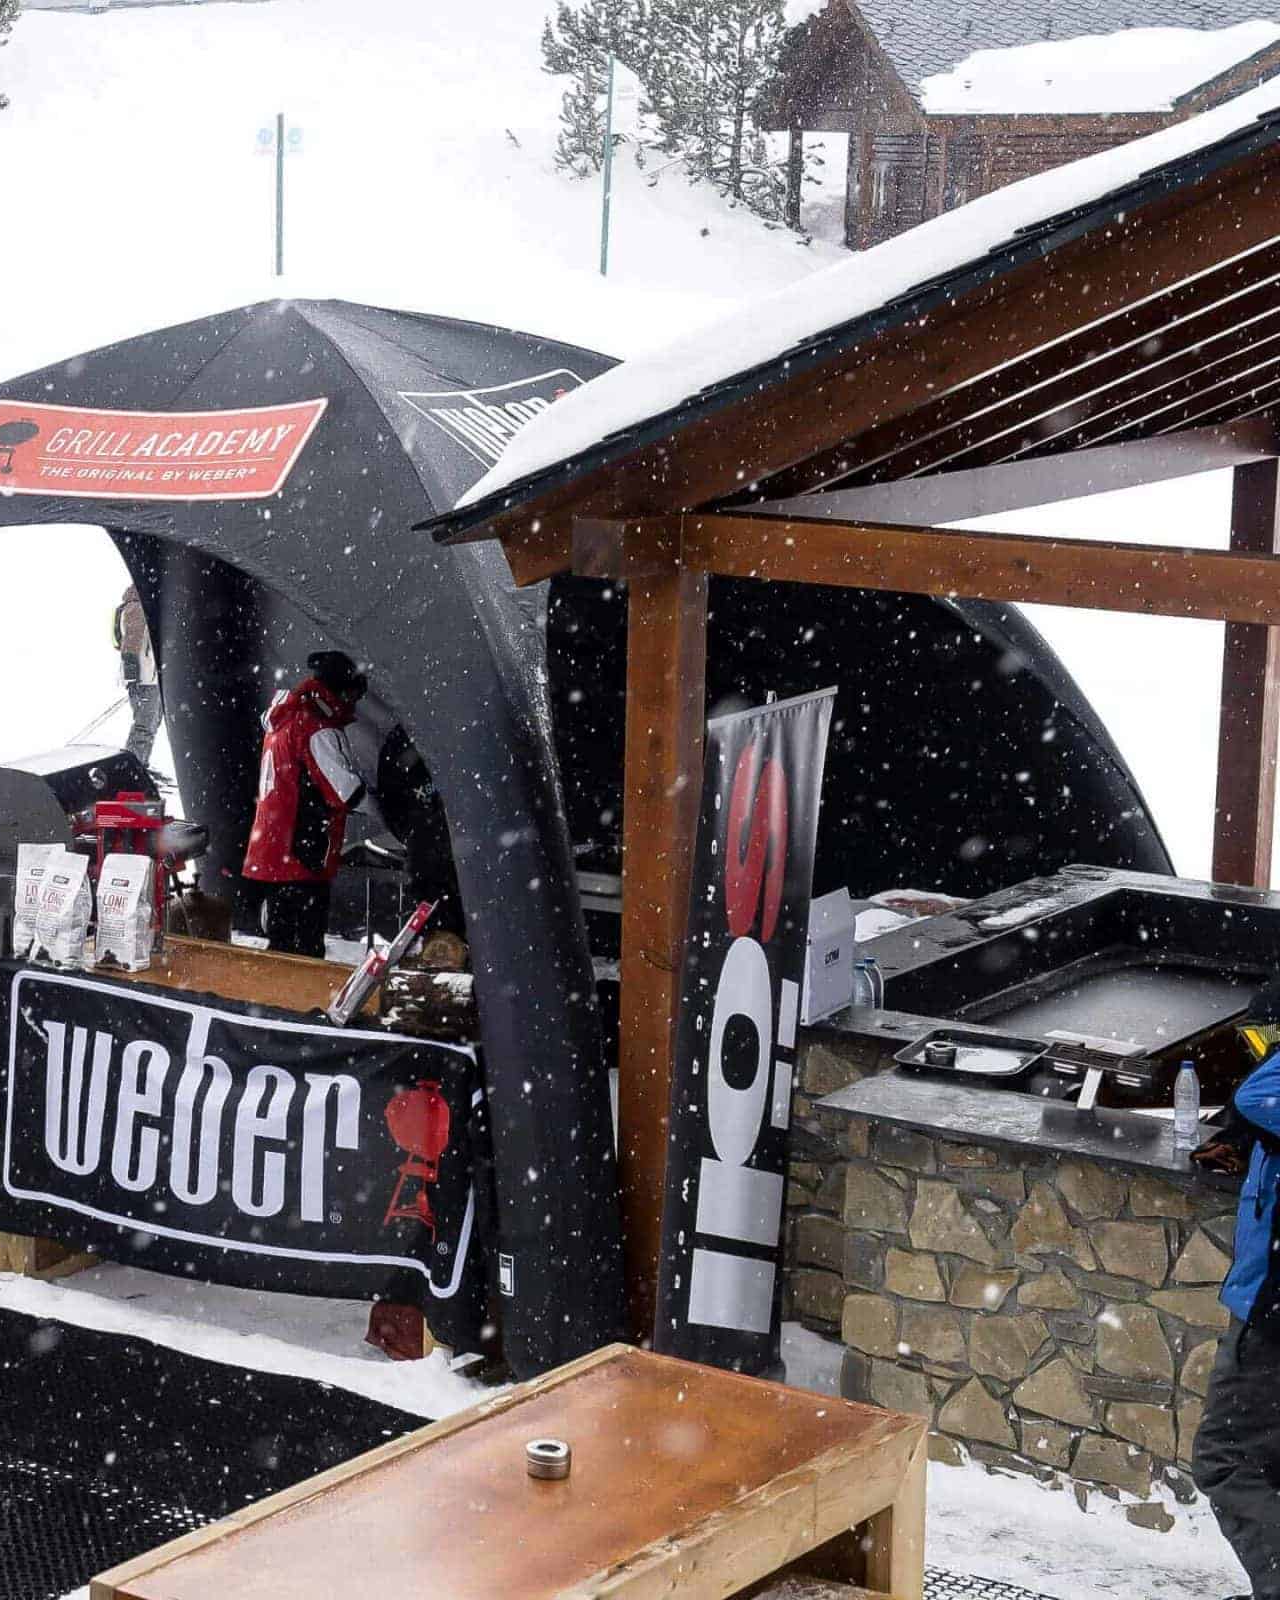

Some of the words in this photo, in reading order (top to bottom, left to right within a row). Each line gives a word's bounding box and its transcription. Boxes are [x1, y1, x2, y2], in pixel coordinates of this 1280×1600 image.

[45, 427, 132, 456] GRILL
[130, 424, 297, 457] ACADEMY
[40, 465, 74, 478] THE
[76, 468, 154, 480] ORIGINAL
[160, 469, 185, 480] BY
